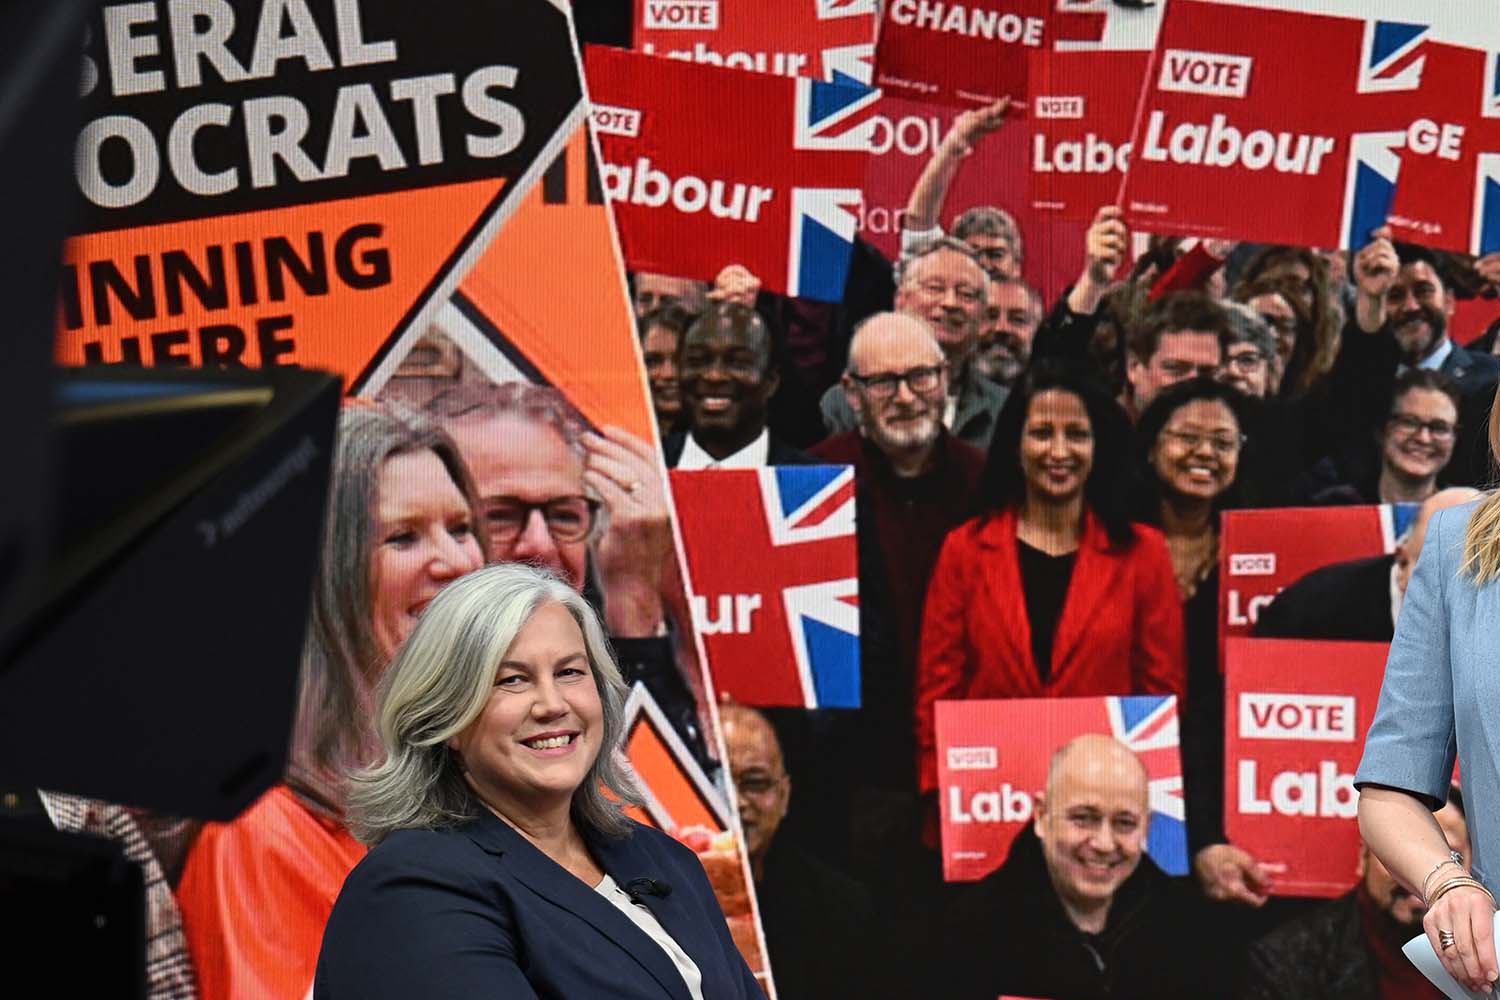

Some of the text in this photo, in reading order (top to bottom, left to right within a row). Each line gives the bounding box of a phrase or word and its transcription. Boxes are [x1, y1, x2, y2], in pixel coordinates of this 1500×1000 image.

[650, 5, 711, 23] VOTE
[80, 0, 397, 97] ERAL
[1170, 57, 1241, 87] VOTE
[592, 110, 634, 131] OTE
[1041, 99, 1078, 114] VOTE
[75, 65, 526, 208] OCRATS
[1141, 110, 1335, 175] Labour
[1407, 118, 1465, 161] GE
[602, 156, 773, 222] abour
[64, 223, 393, 331] INNING
[1250, 703, 1344, 732] VOTE
[949, 783, 1034, 823] Lab
[1238, 759, 1360, 819] Lab
